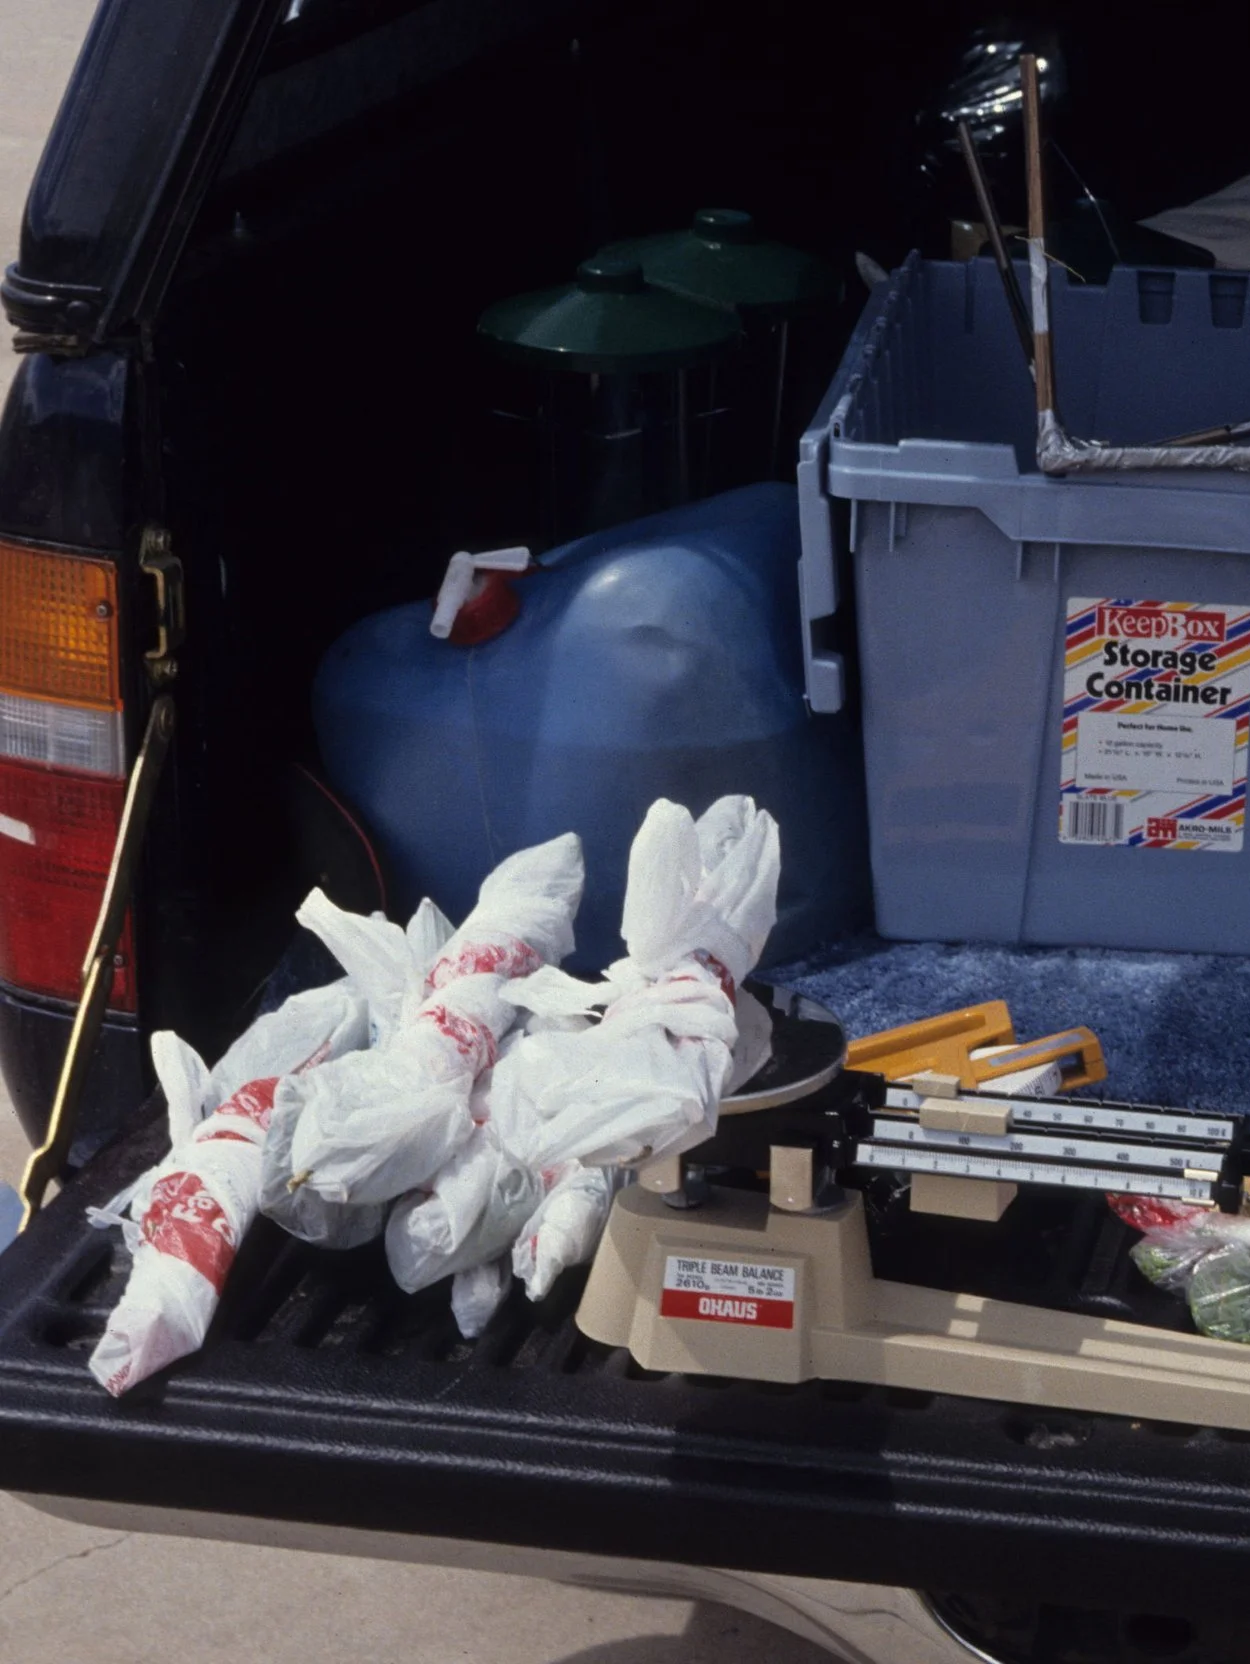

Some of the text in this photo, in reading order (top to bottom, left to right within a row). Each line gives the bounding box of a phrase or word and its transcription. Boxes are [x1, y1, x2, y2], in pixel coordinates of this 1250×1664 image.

[1103, 608, 1220, 640] KeepBox
[1103, 641, 1218, 676] Storage
[1086, 672, 1232, 705] Container
[677, 1260, 706, 1274] TRIPLE
[710, 1263, 738, 1277] BEAM
[742, 1266, 784, 1281] BALANCE
[699, 1297, 757, 1320] OHAUS
